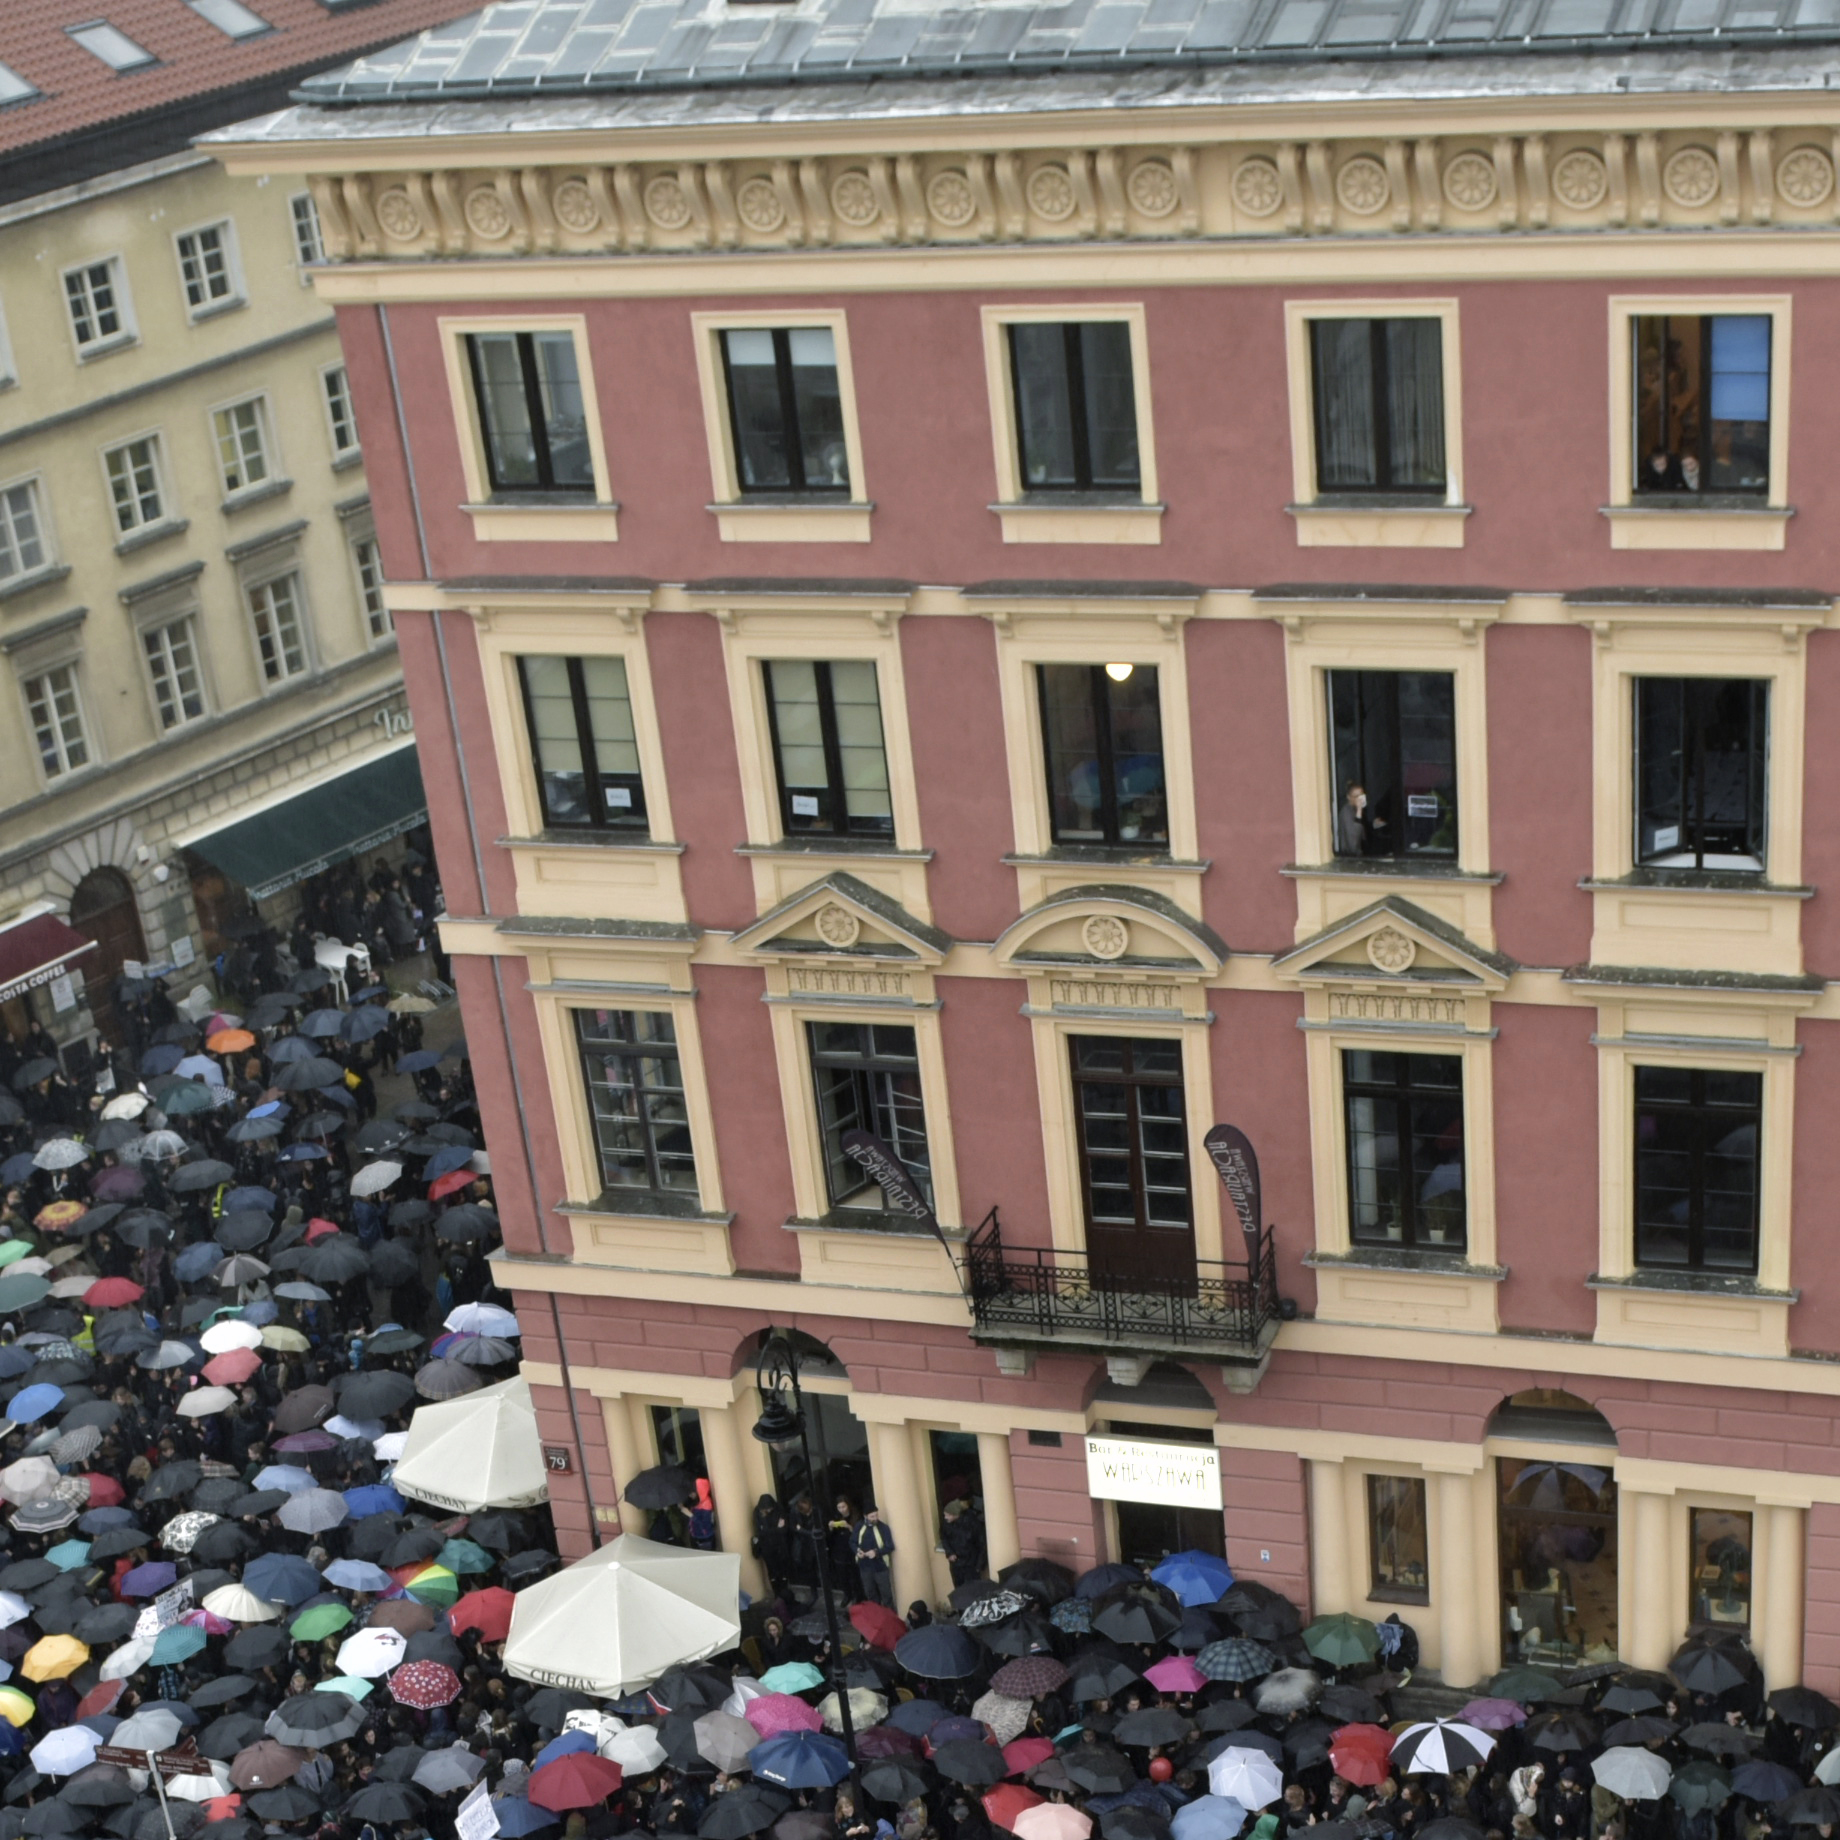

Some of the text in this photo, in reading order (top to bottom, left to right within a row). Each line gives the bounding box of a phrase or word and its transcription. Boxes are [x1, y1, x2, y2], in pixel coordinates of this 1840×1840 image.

[29, 964, 66, 987] COFFEE
[549, 1456, 566, 1470] 79
[414, 1487, 468, 1512] CIECHAN
[530, 1668, 597, 1692] CIECHAN
